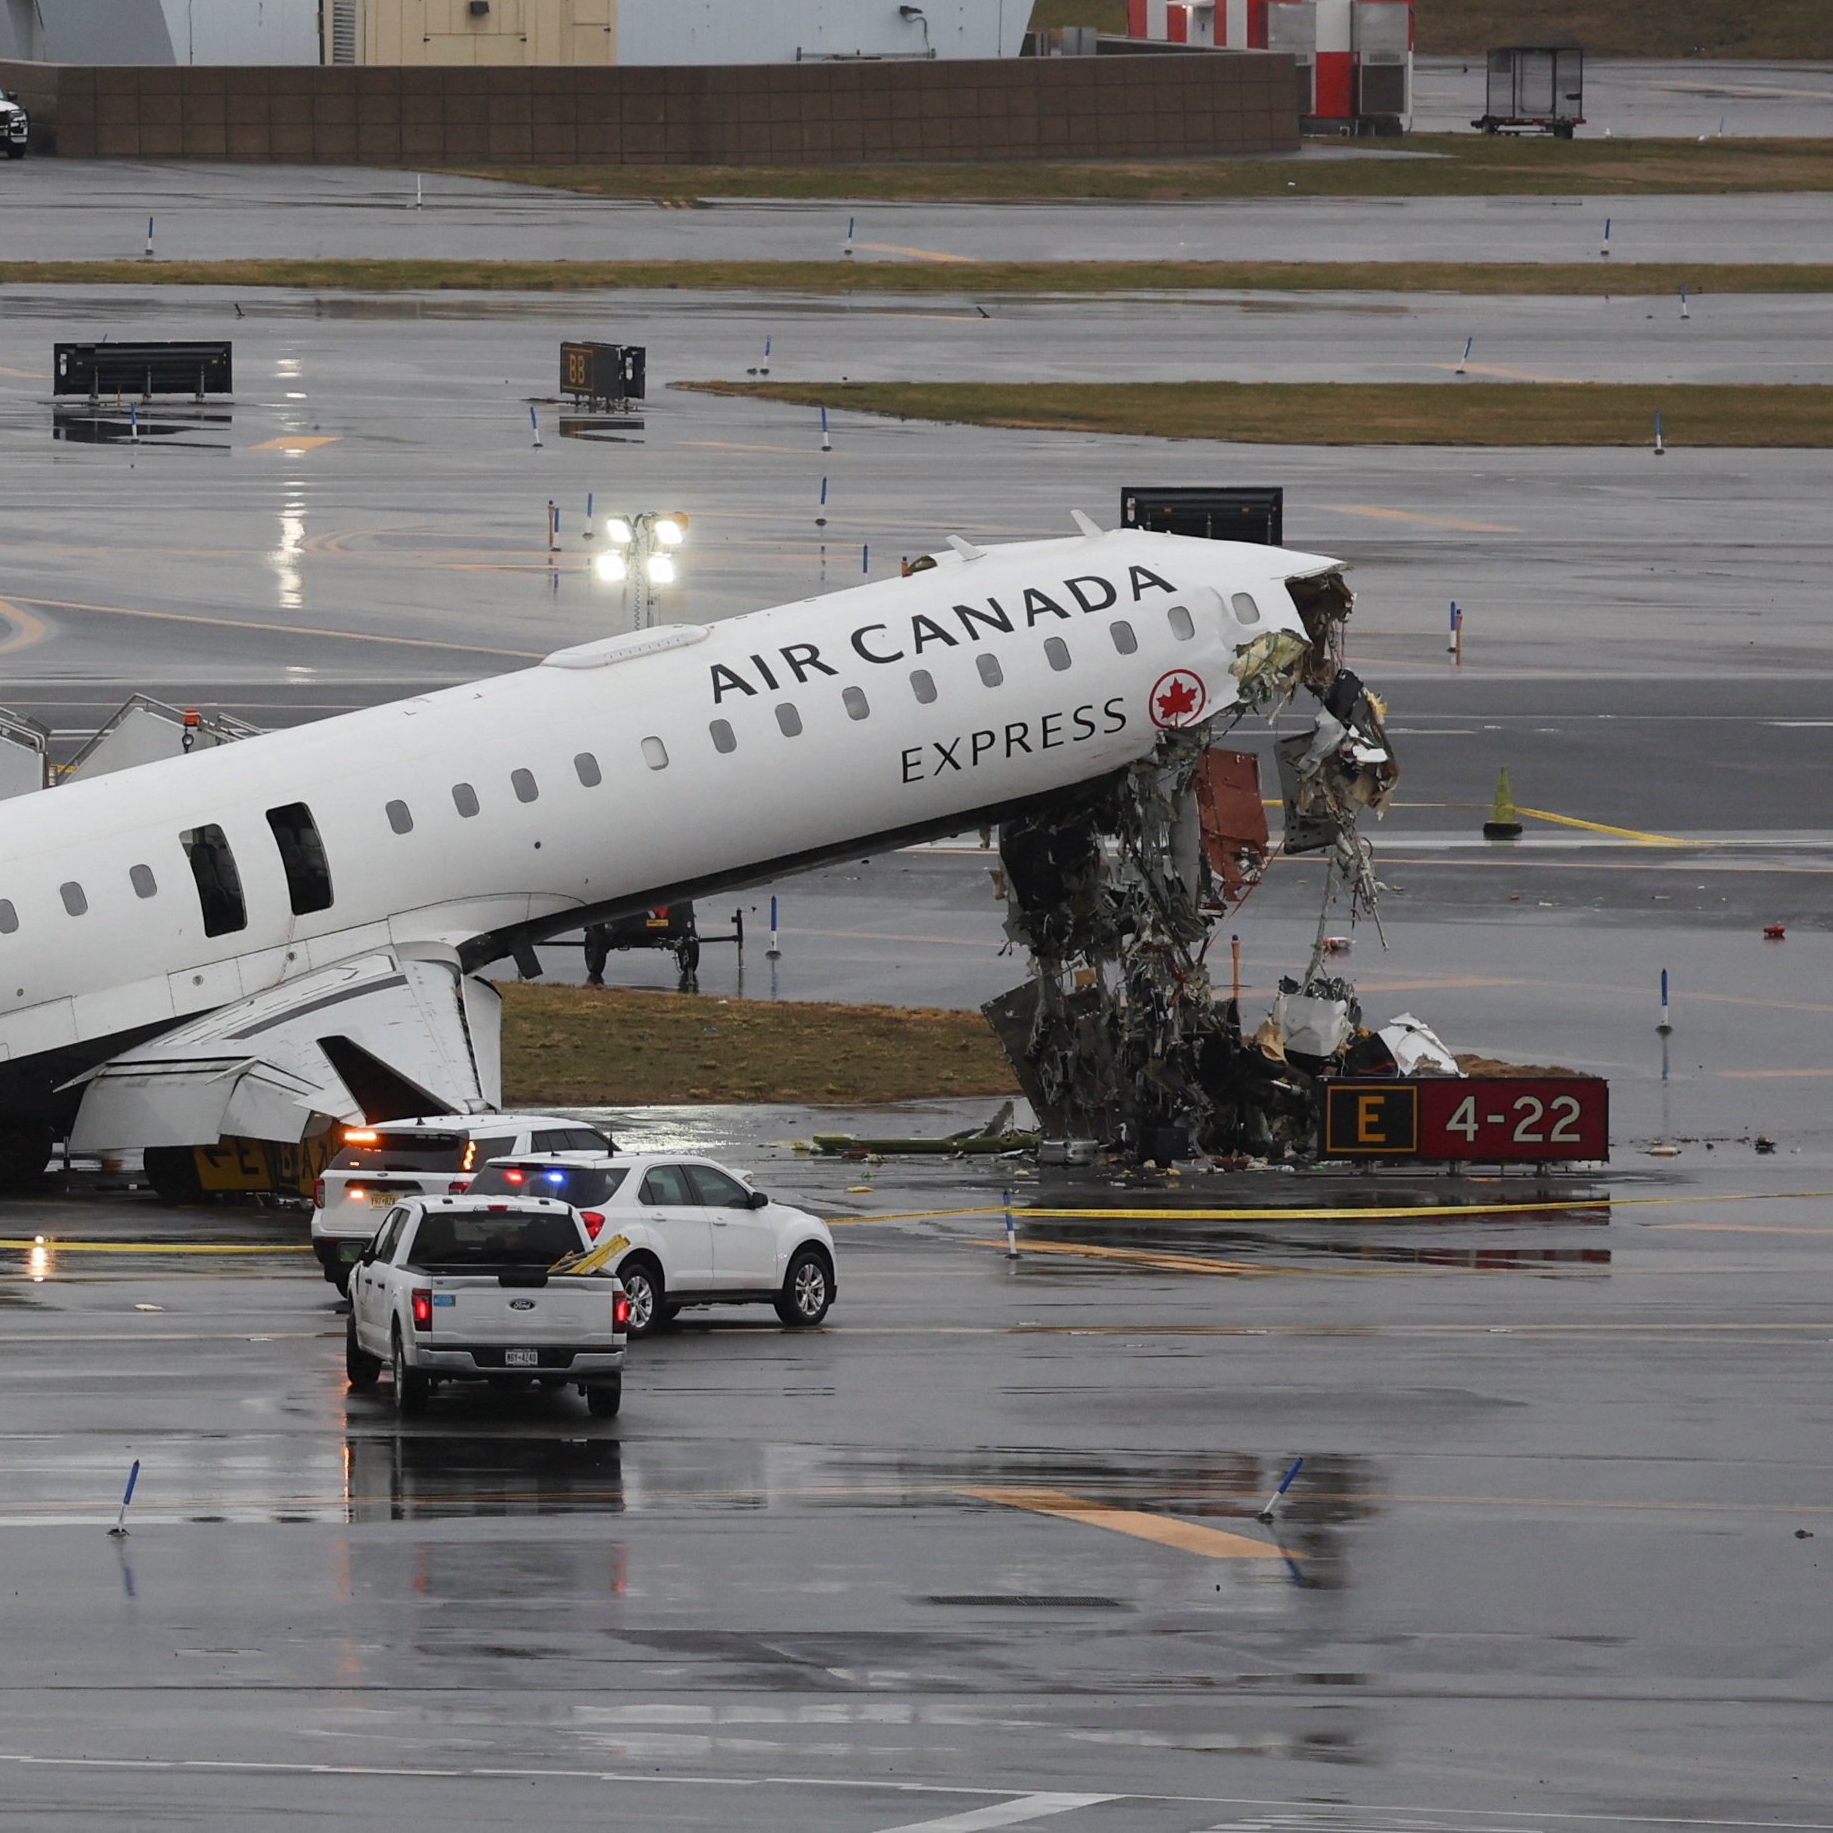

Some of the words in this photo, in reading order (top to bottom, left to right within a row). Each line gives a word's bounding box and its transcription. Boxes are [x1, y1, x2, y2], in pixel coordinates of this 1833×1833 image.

[709, 642, 840, 705] AIR
[850, 564, 1178, 665] CANADA
[900, 697, 1128, 784] EXPRESS
[1357, 1095, 1386, 1143] E
[1445, 1095, 1581, 1143] 4-22
